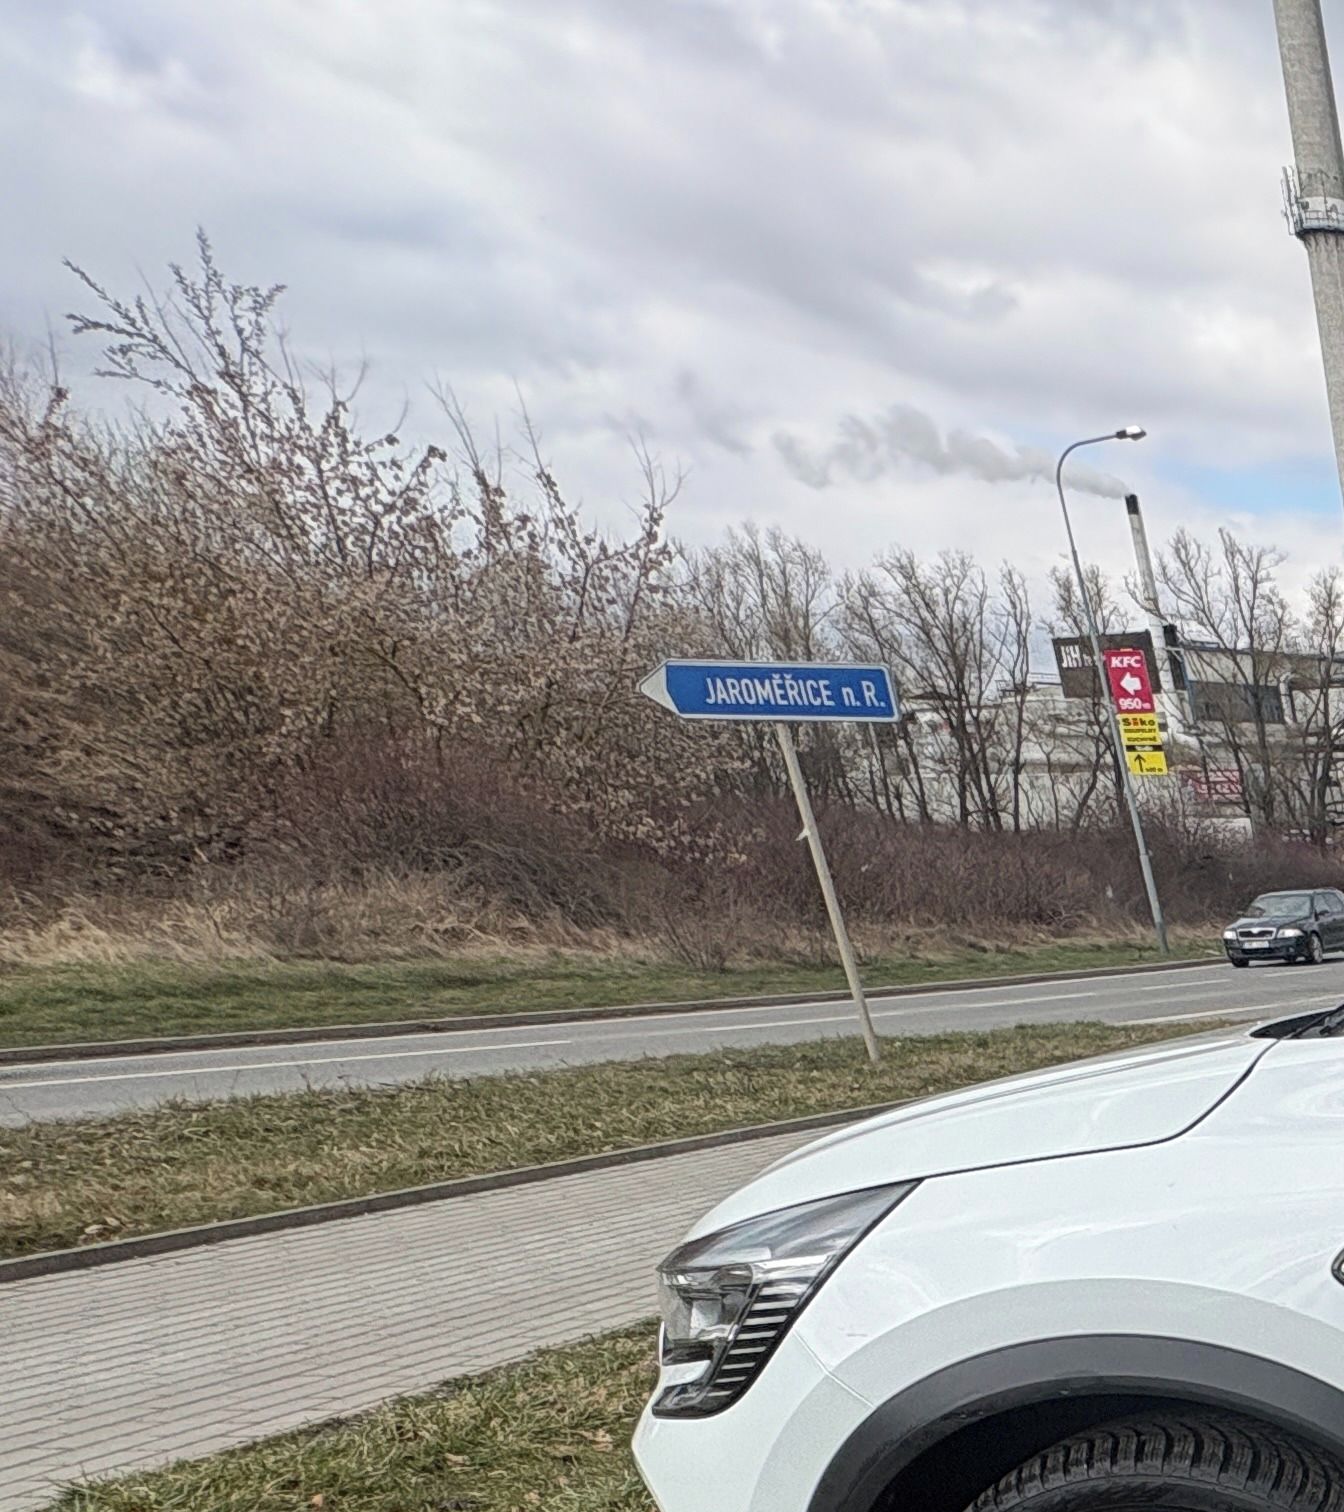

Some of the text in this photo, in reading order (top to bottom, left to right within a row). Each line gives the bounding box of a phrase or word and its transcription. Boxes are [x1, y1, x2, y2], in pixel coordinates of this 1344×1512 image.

[1111, 656, 1141, 668] KFC
[705, 673, 886, 707] JAROMĚŘICE n. R.
